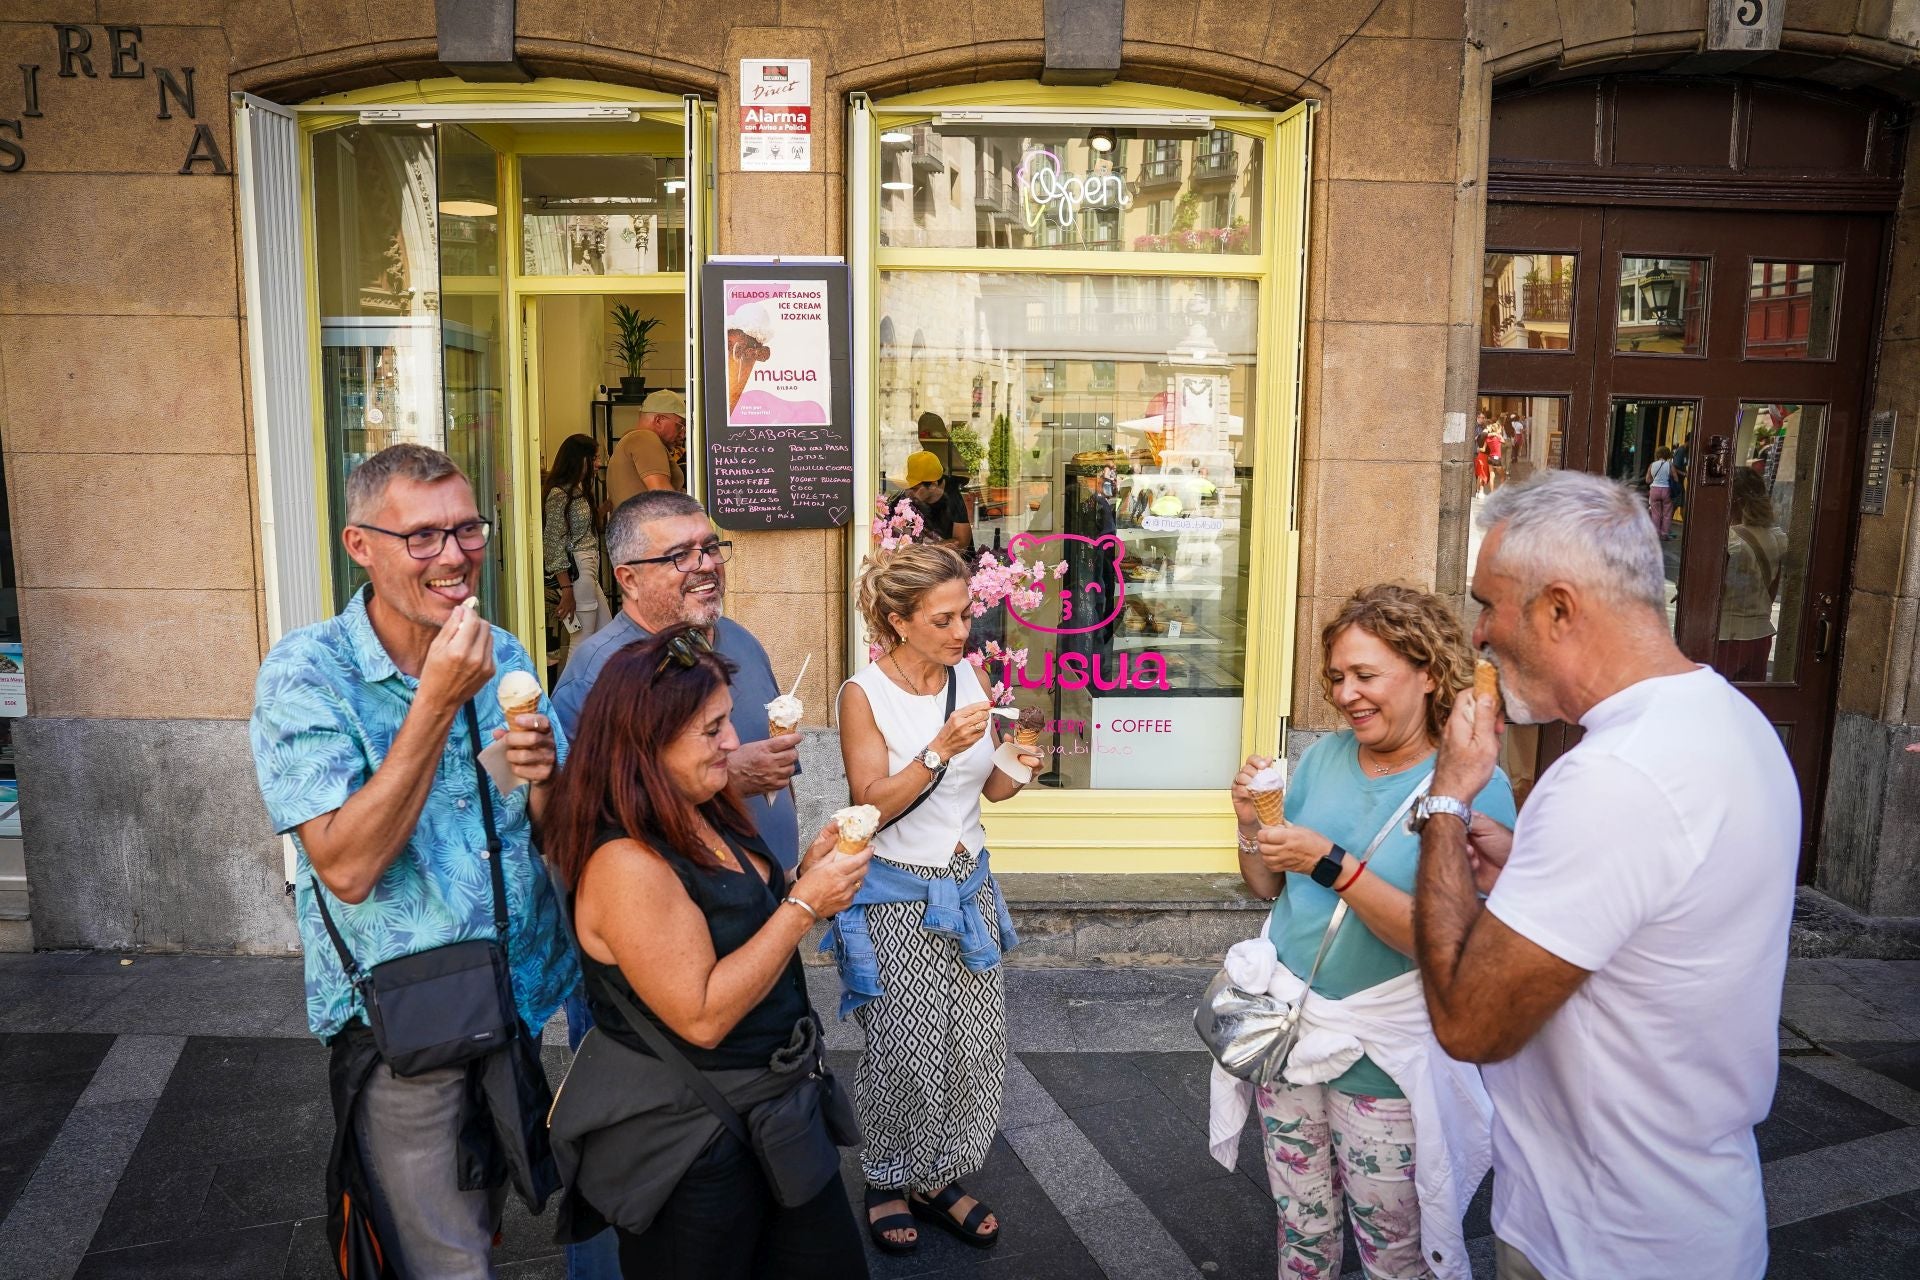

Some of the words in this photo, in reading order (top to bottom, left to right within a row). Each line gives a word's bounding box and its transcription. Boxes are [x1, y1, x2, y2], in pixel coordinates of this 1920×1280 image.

[752, 80, 800, 100] Direct
[744, 109, 807, 123] Alarma
[1031, 167, 1129, 227] Open
[754, 369, 817, 382] musua
[747, 428, 819, 440] SABORES
[712, 444, 775, 454] PISTACCIO
[715, 457, 757, 466] MANGO
[714, 468, 775, 476] FRAMBUESA
[716, 478, 770, 486] BANOFFEE
[1042, 719, 1087, 734] KERY
[1111, 720, 1172, 733] COFFEE
